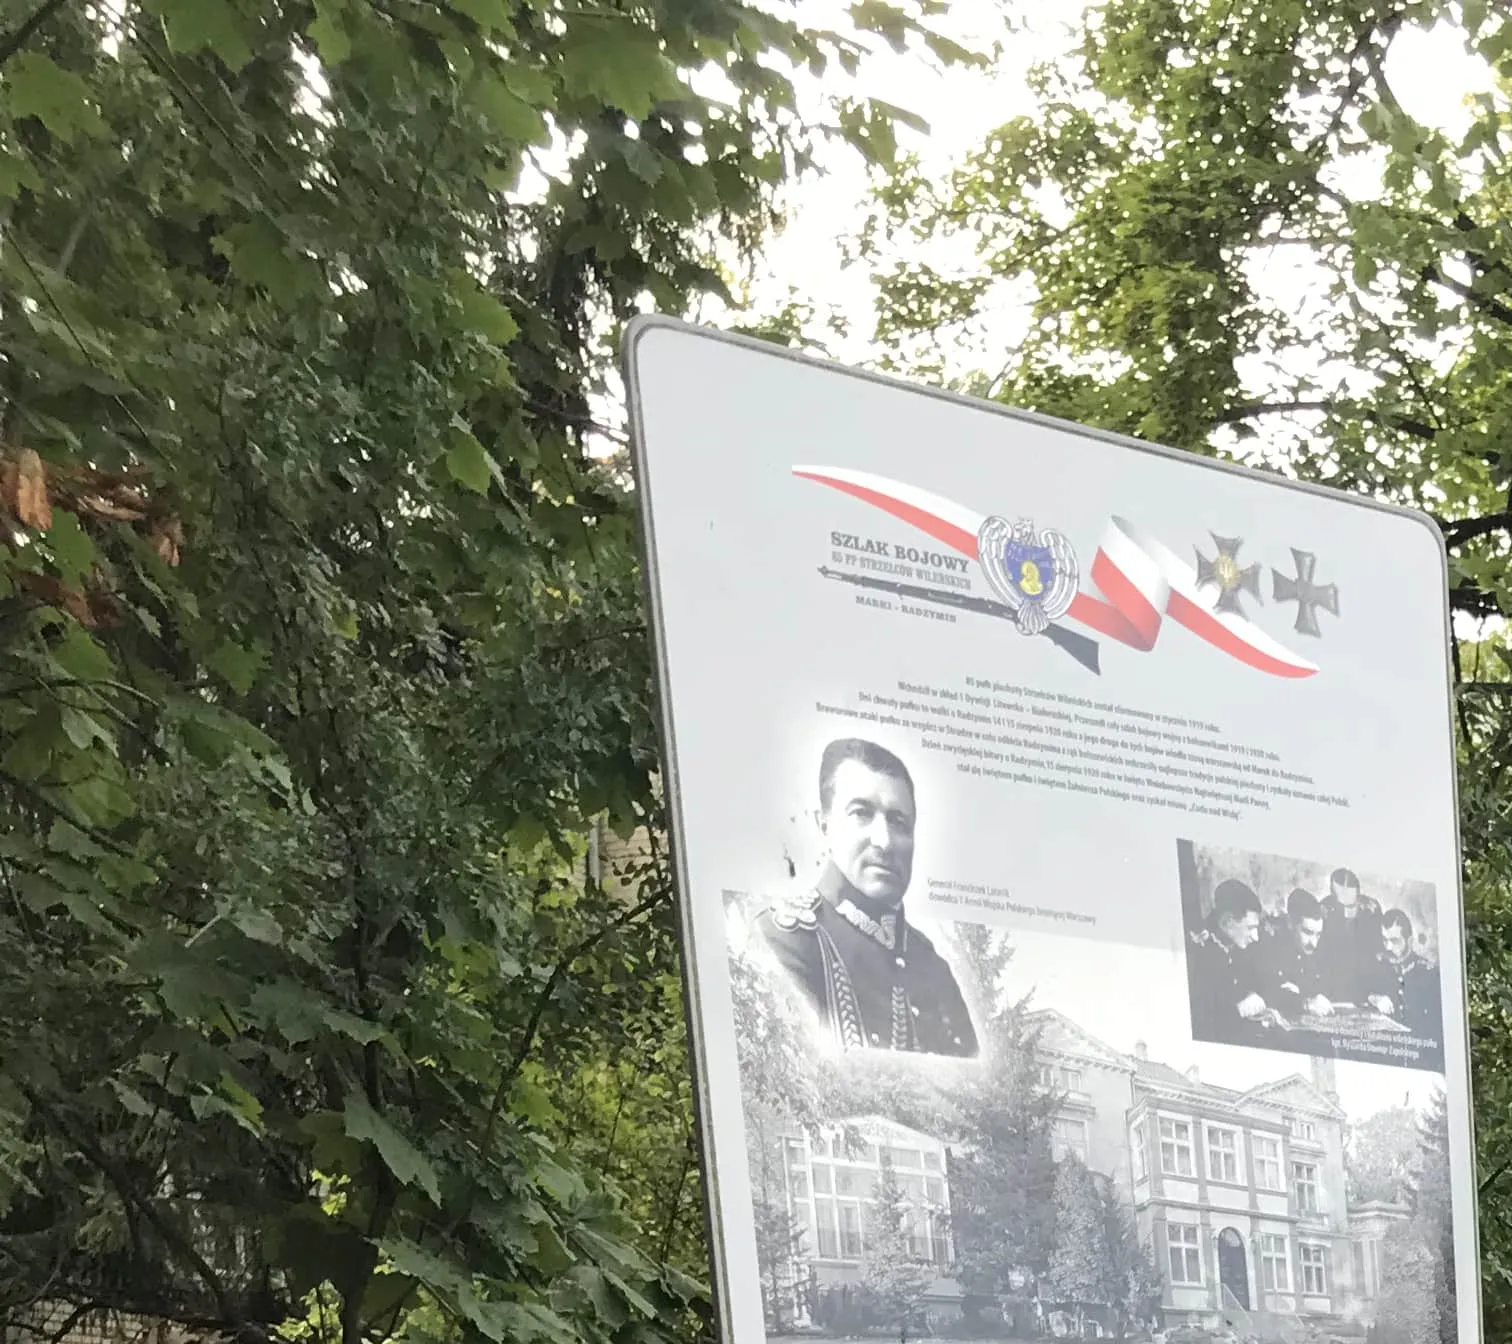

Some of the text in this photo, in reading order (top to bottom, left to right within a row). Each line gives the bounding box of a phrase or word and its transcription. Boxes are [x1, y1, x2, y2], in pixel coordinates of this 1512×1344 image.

[830, 531, 969, 573] SZLAK BOJOWY
[855, 594, 956, 623] MARKI RADZYMIN
